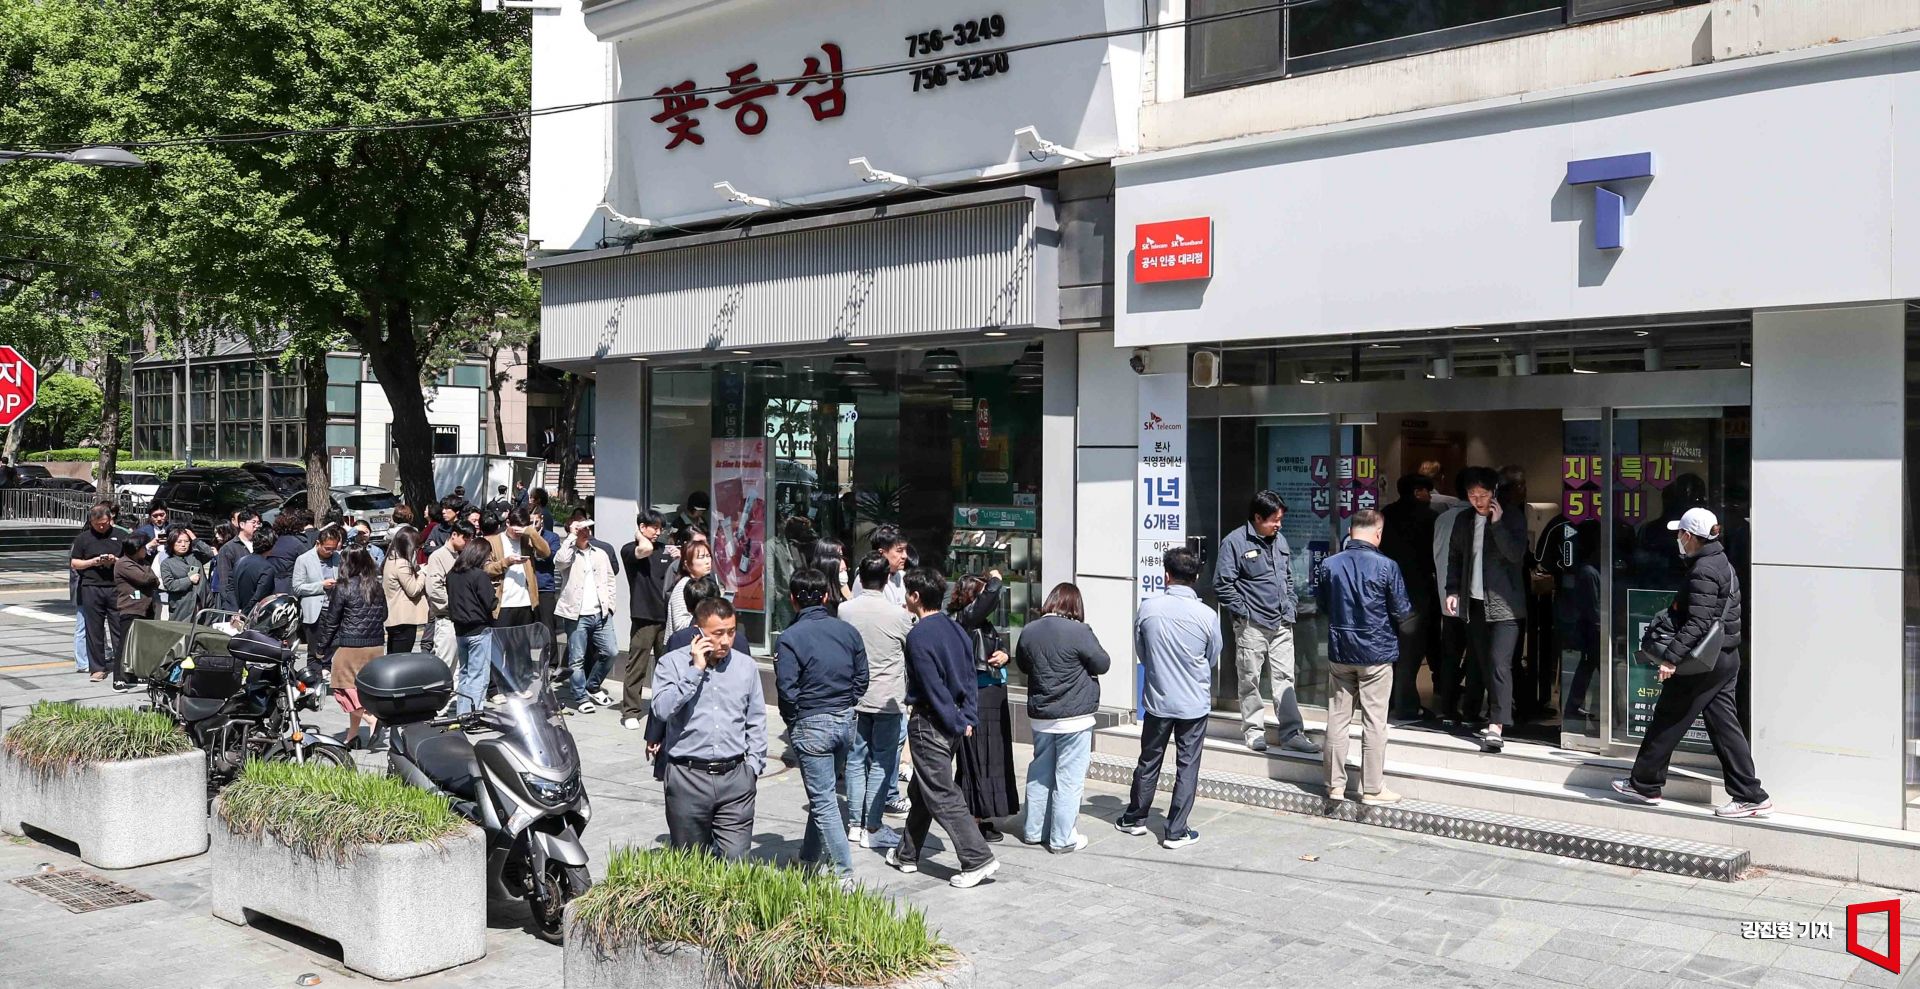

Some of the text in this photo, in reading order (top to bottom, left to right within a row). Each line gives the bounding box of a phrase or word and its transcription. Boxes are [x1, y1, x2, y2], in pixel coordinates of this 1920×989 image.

[905, 14, 1005, 57] 756-3249
[909, 52, 1010, 92] 756-3250
[651, 43, 847, 149] 꽃등심
[1142, 243, 1149, 251] SK
[1180, 239, 1203, 247] broadband
[1141, 252, 1203, 268] 공식 인증 대리점
[1144, 421, 1154, 430] SK
[1155, 441, 1171, 453] 본사
[1143, 456, 1182, 467] 직영점에선
[1144, 477, 1179, 506] 1년
[1312, 490, 1376, 511] 선착순
[1144, 514, 1180, 530] 6개월
[1154, 541, 1170, 553] 이상
[1140, 555, 1165, 567] 사용하
